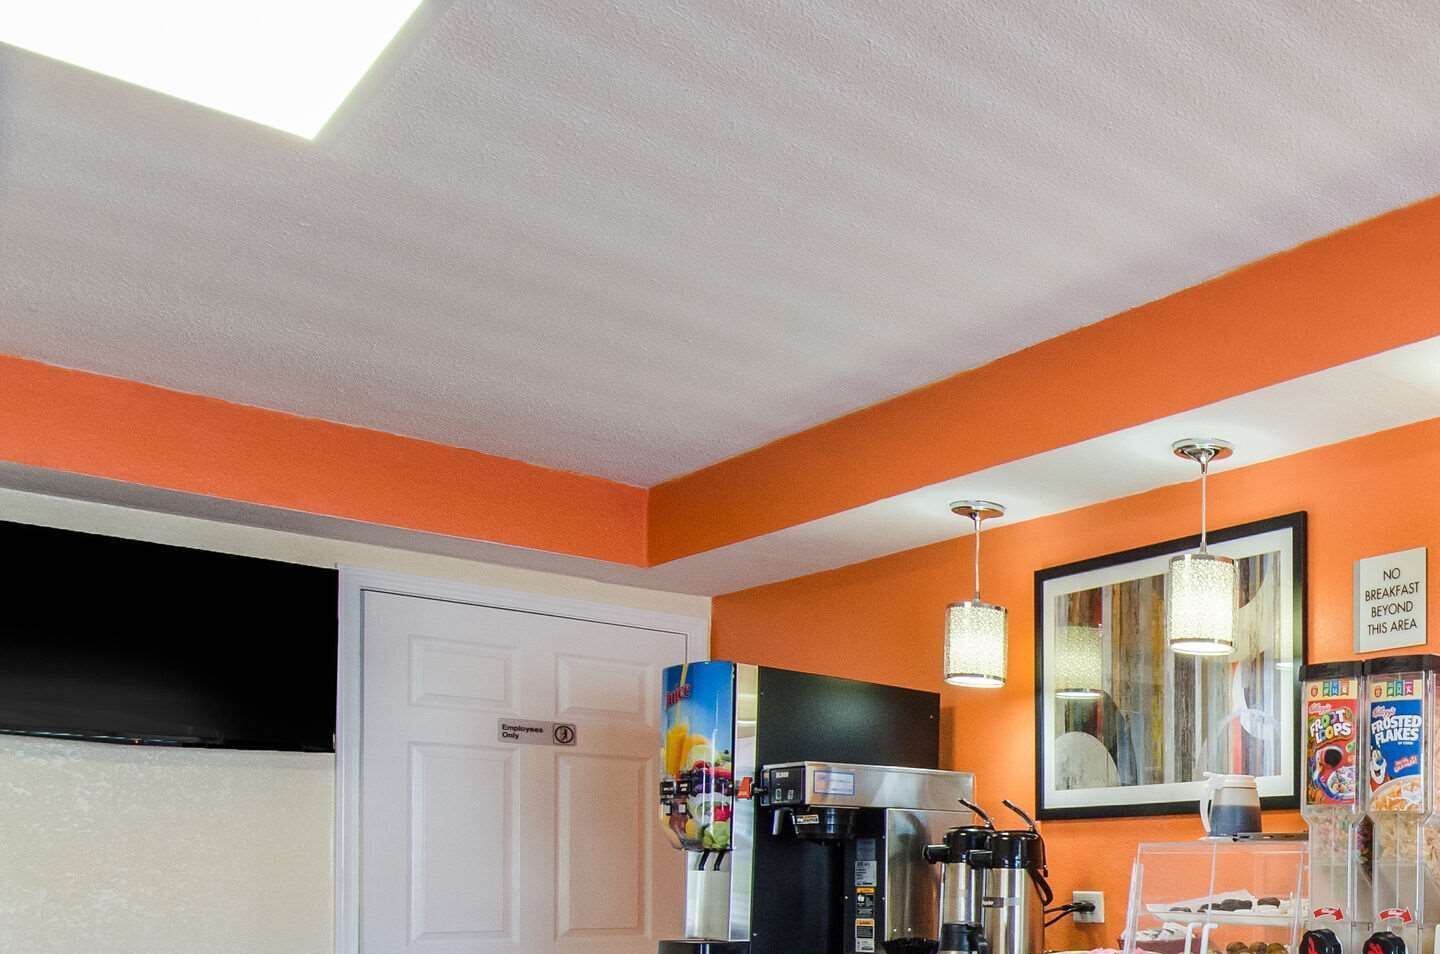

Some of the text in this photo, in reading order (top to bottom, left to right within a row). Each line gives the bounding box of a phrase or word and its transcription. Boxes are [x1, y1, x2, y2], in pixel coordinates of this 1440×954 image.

[1383, 567, 1401, 581] NO
[1365, 581, 1420, 602] BREAKFAST
[1371, 600, 1414, 618] BEYOND
[1367, 618, 1418, 635] THIS AREA
[502, 724, 543, 733] Employees
[1371, 715, 1422, 734] FROSTED
[502, 731, 519, 740] Only
[1375, 727, 1419, 748] FLAKES
